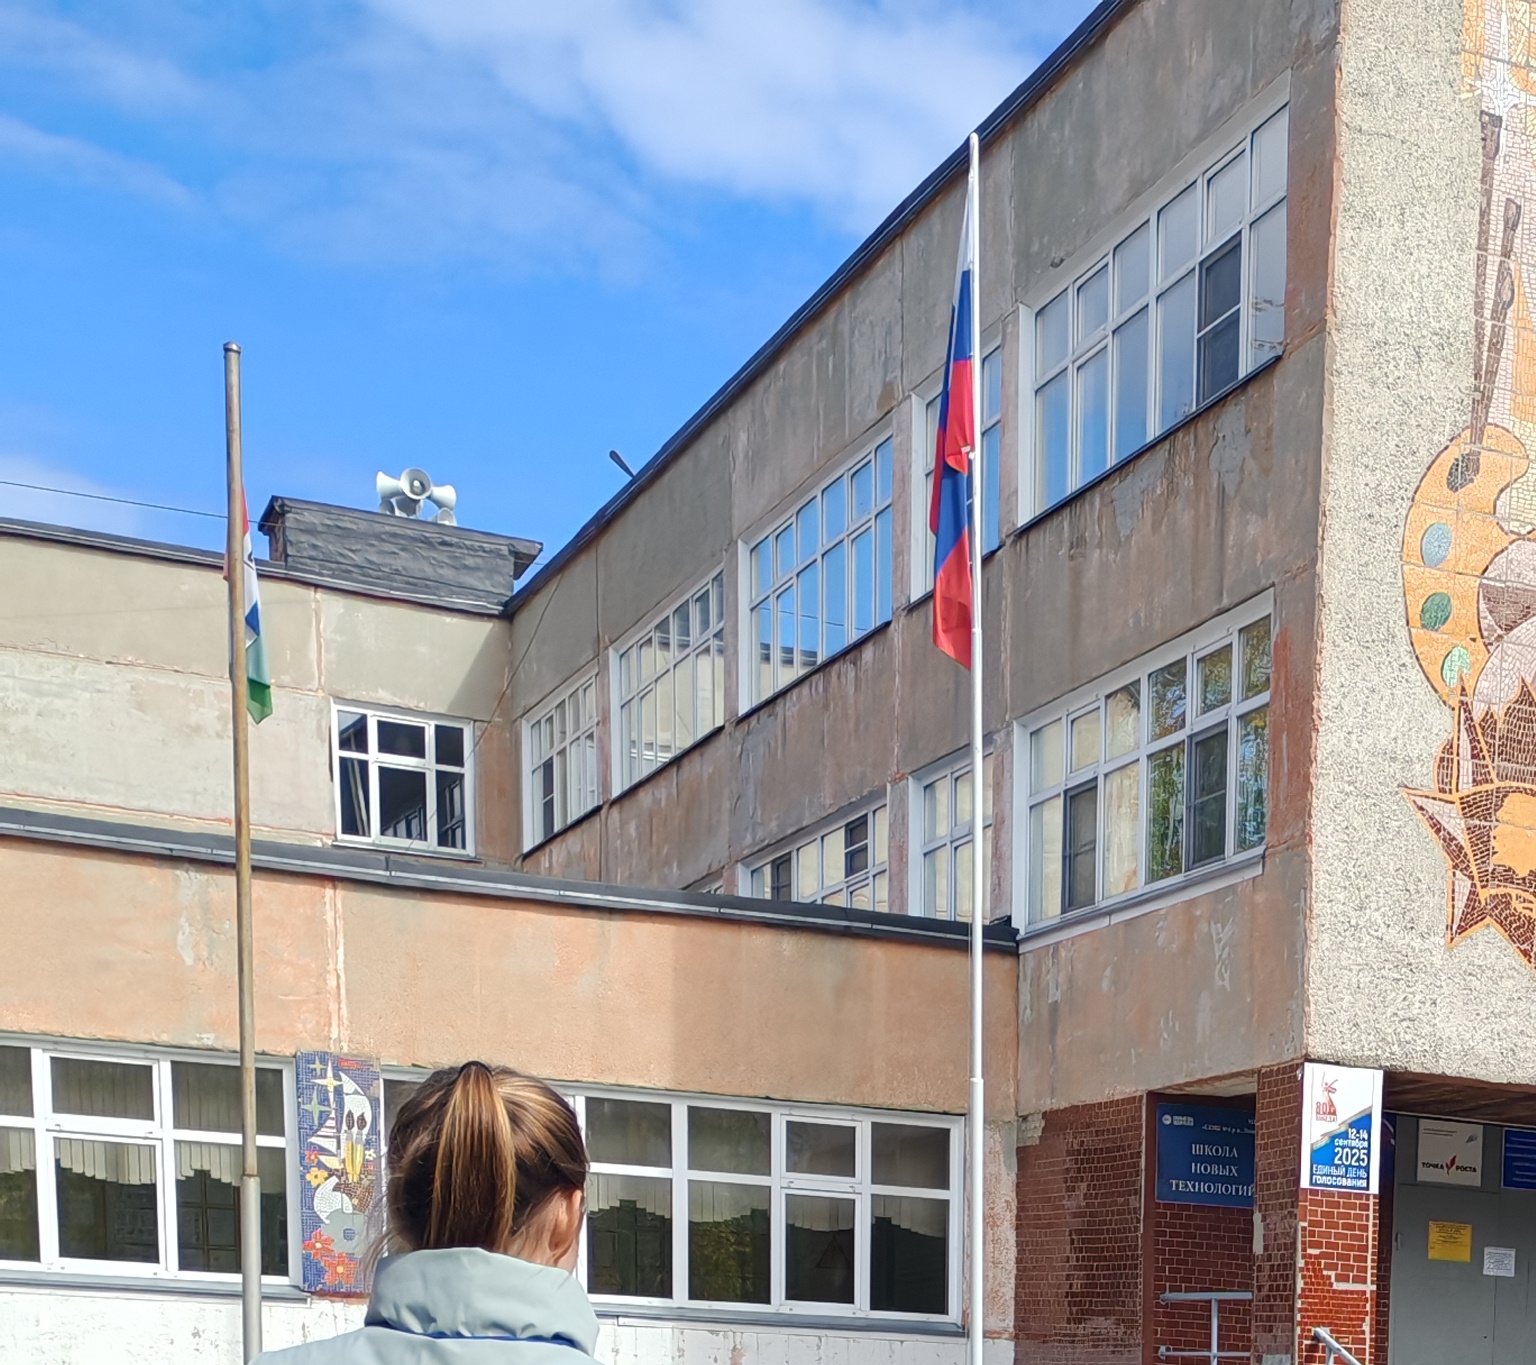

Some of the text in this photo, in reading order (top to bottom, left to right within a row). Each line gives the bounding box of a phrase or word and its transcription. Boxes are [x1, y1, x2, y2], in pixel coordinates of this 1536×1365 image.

[1348, 1128, 1368, 1140] 12-14
[1192, 1143, 1238, 1158] ШКОЛА
[1334, 1147, 1368, 1167] 2025
[1191, 1162, 1238, 1177] НОВЫХ
[1313, 1164, 1368, 1178] ЕДИНЫЙ ДЕНЬ
